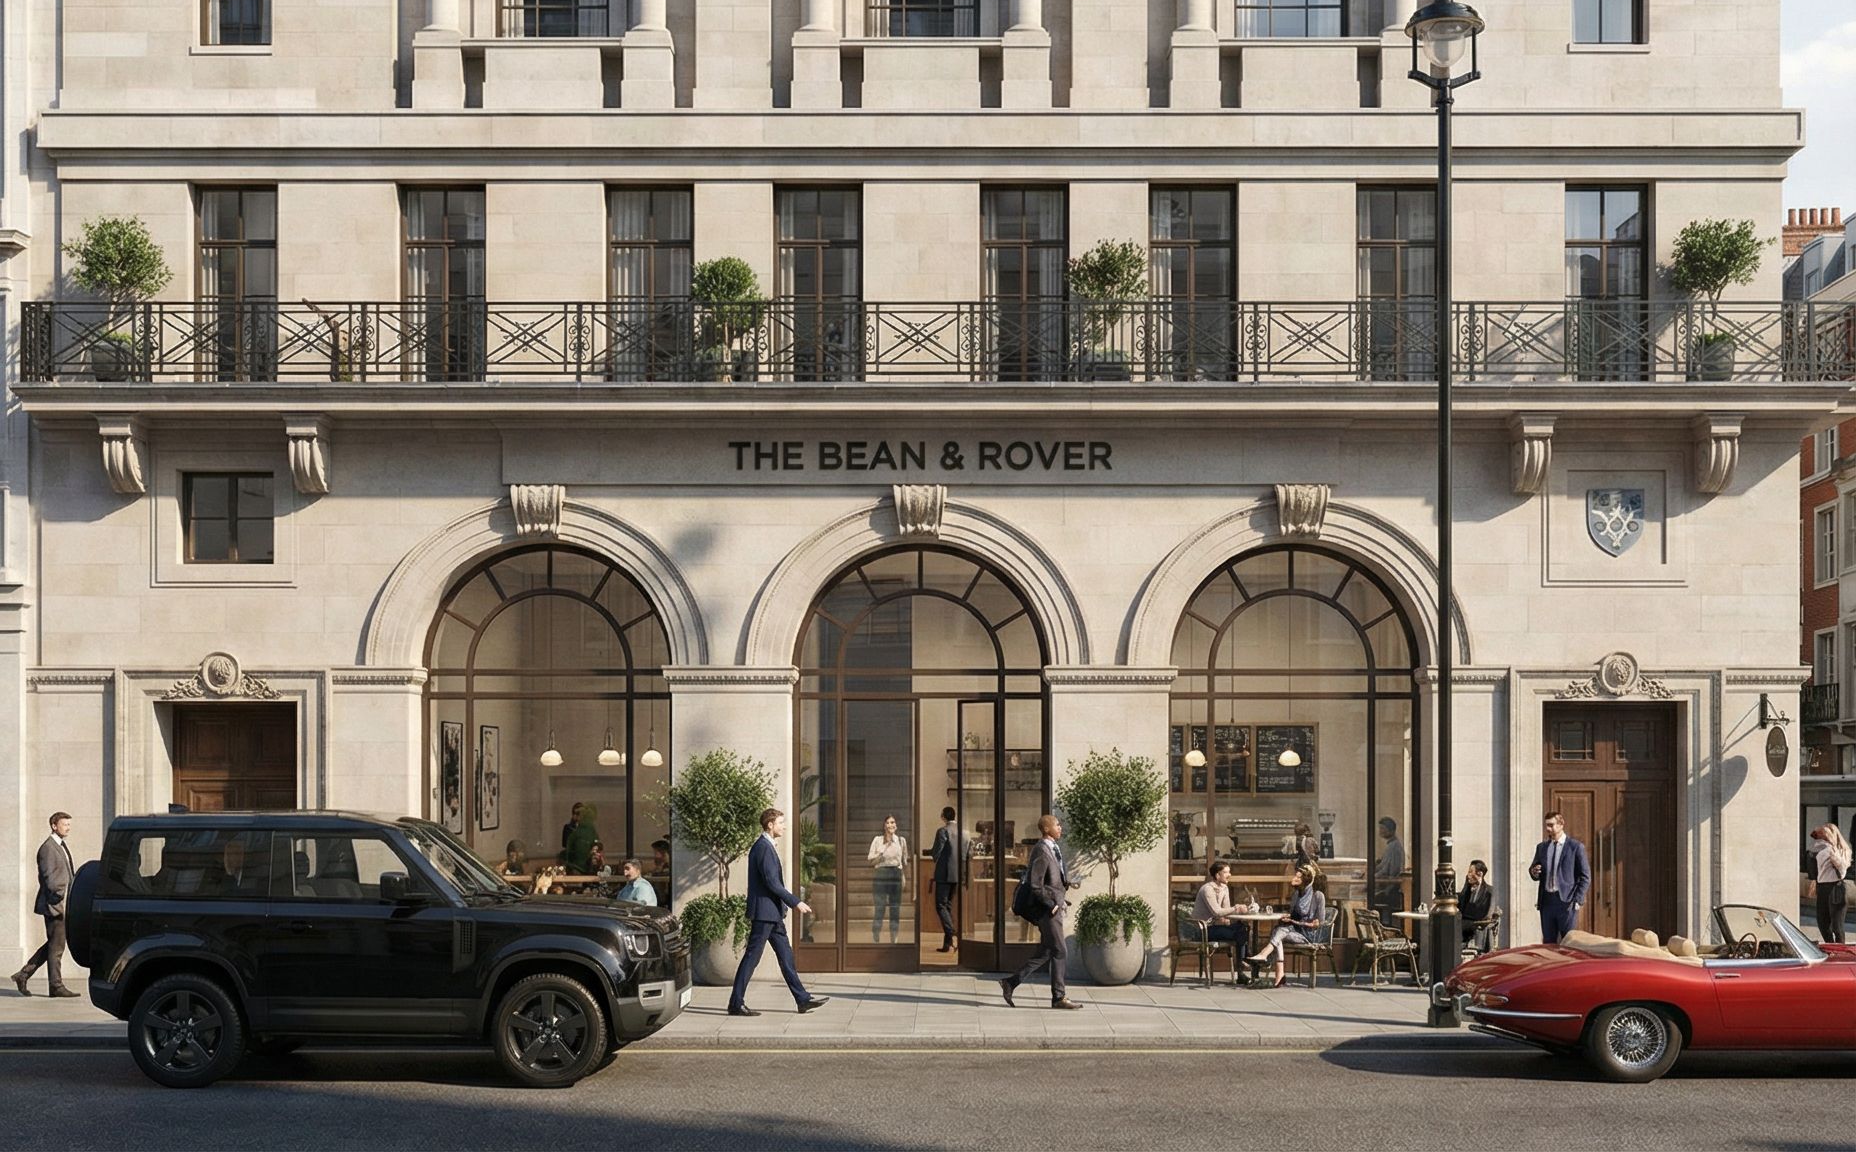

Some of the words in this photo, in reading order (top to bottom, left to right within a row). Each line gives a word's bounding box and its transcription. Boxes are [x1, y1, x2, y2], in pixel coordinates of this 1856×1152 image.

[728, 441, 804, 470] THE
[818, 441, 926, 470] BEAN
[939, 441, 965, 470] &
[978, 441, 1113, 470] ROVER
